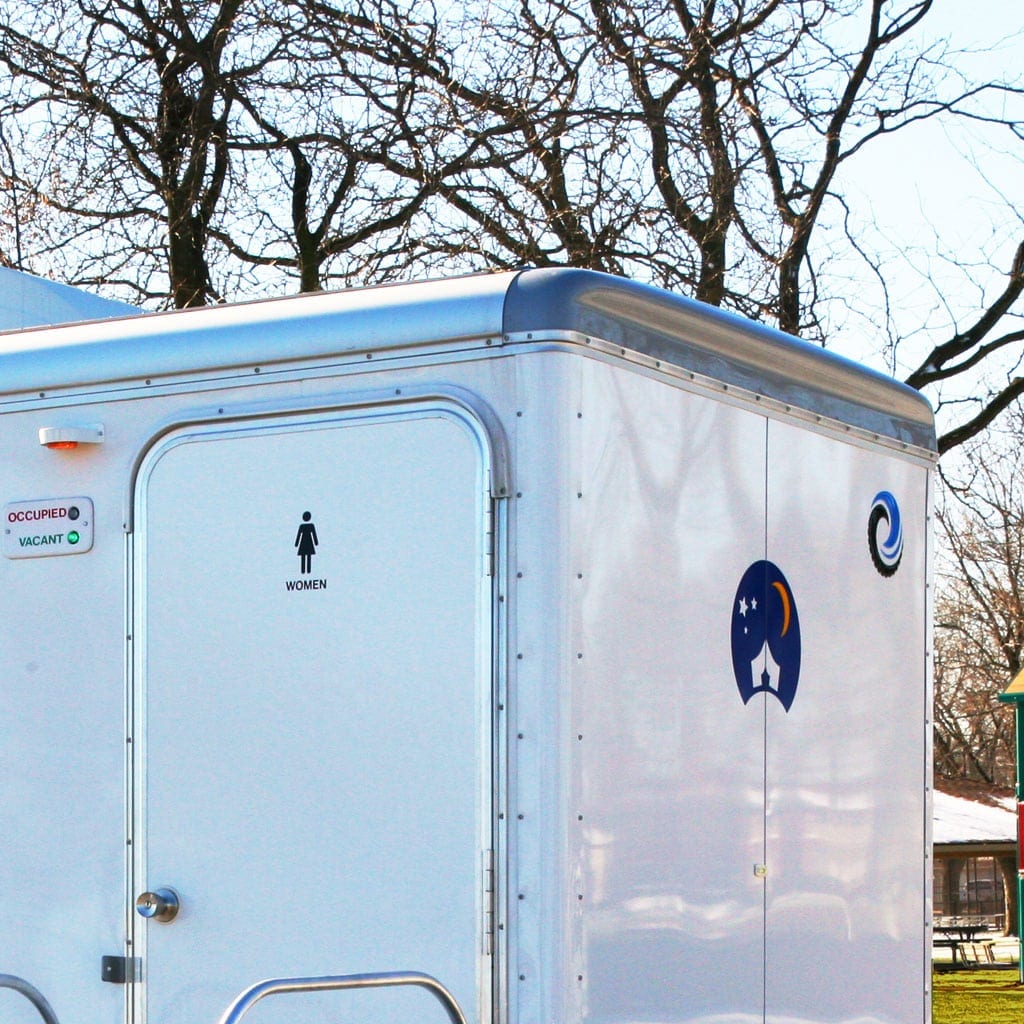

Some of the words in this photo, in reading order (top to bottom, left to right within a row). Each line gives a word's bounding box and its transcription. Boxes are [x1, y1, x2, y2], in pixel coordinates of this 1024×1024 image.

[8, 508, 67, 522] OCCUPIED
[19, 534, 64, 547] VACANT
[286, 579, 327, 591] WOMEN
